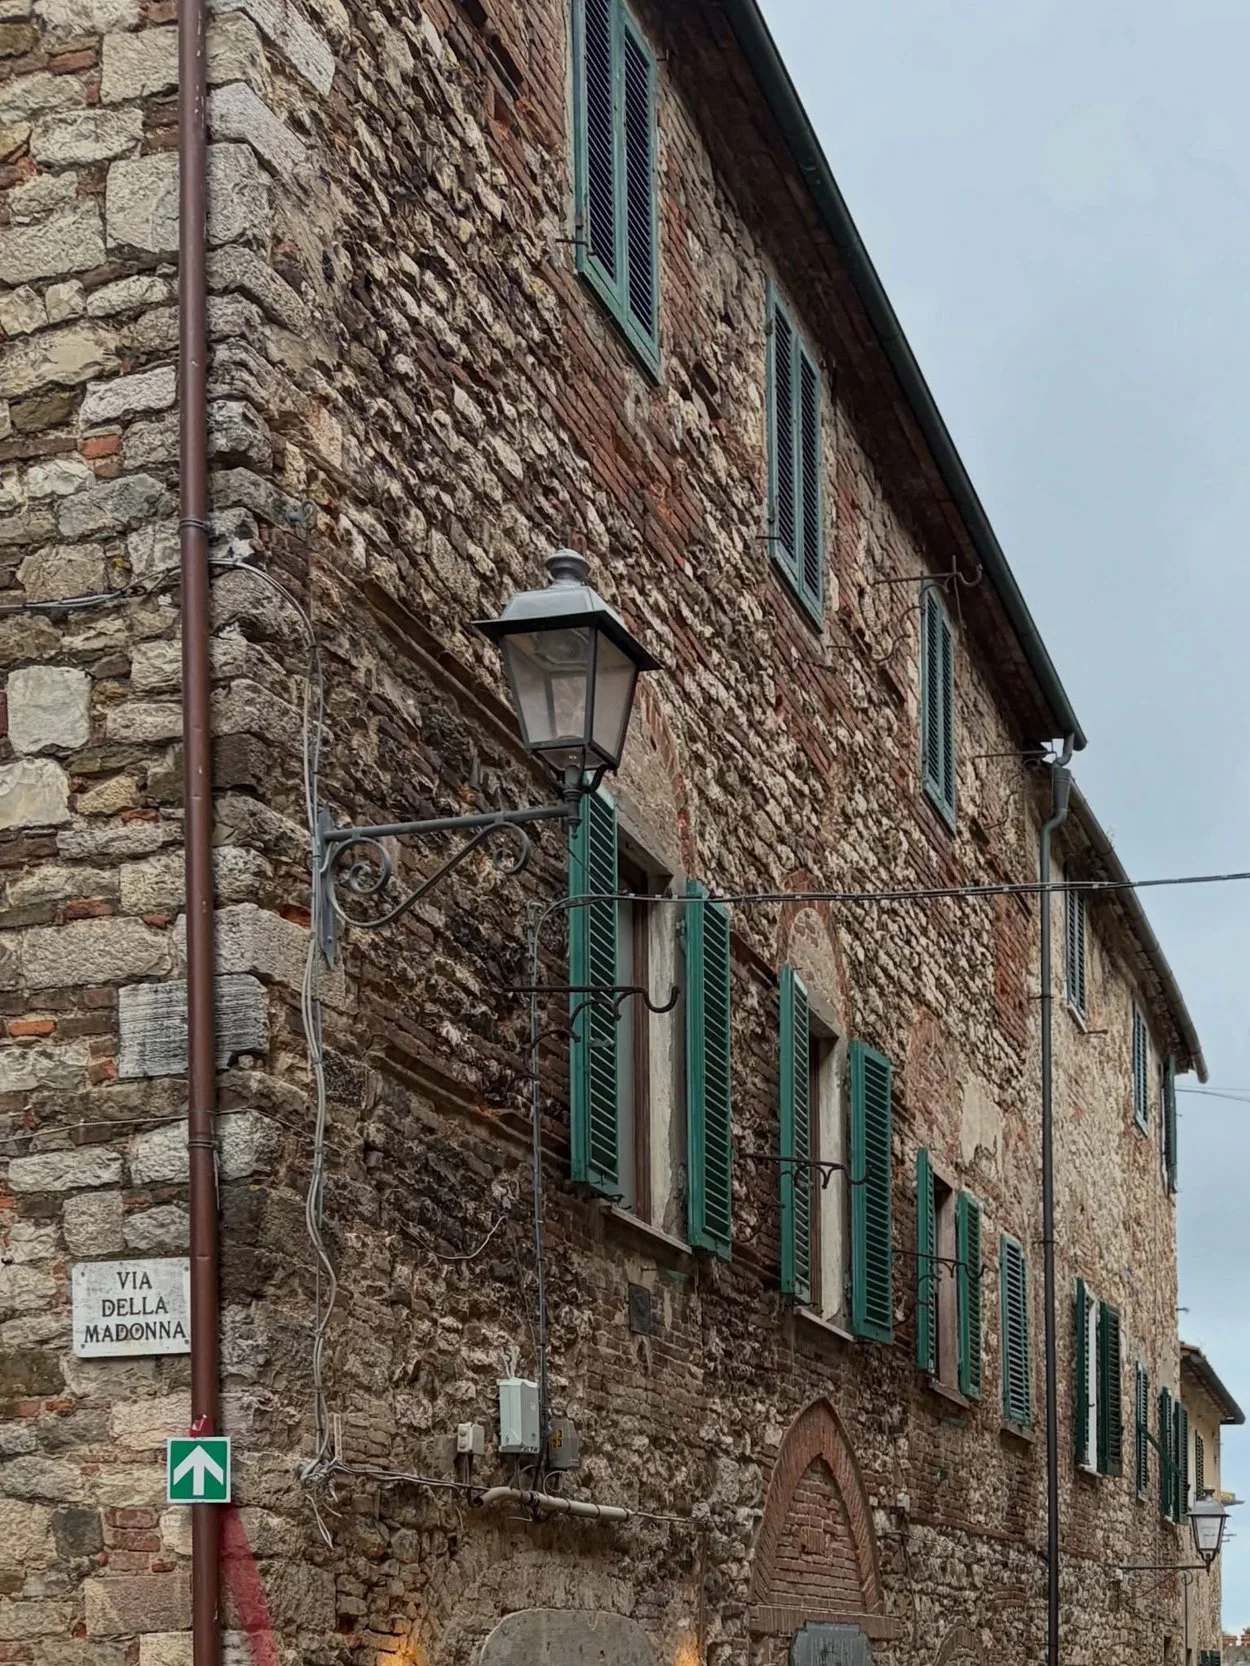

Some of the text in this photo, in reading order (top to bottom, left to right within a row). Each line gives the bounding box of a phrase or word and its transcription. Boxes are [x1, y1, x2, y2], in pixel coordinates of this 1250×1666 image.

[116, 1271, 153, 1290] VIA
[101, 1296, 169, 1318] DELLA
[84, 1320, 187, 1343] MADONNA
